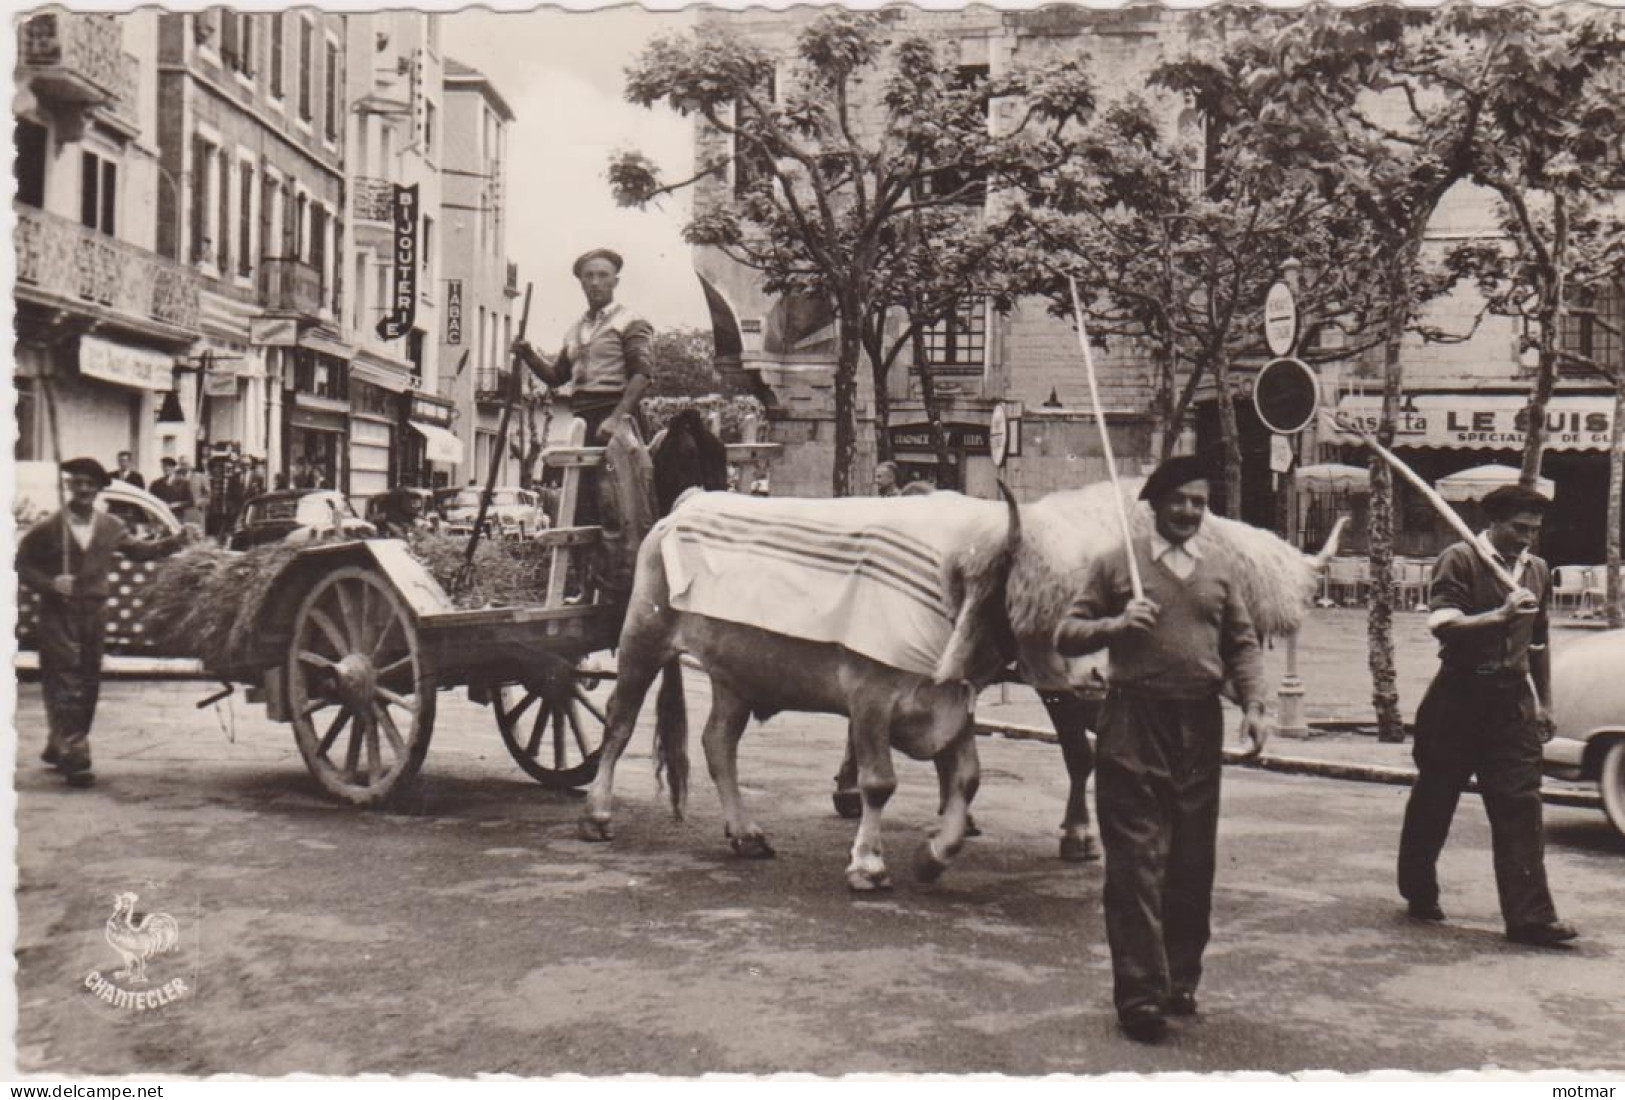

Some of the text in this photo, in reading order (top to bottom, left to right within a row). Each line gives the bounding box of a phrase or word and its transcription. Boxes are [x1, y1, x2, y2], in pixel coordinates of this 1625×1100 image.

[386, 192, 413, 336] BIJOUTERIE
[449, 281, 460, 344] TABAC
[1335, 411, 1426, 430] Casta
[1447, 411, 1495, 431] LE
[1562, 434, 1580, 442] DE
[1591, 434, 1613, 442] GL
